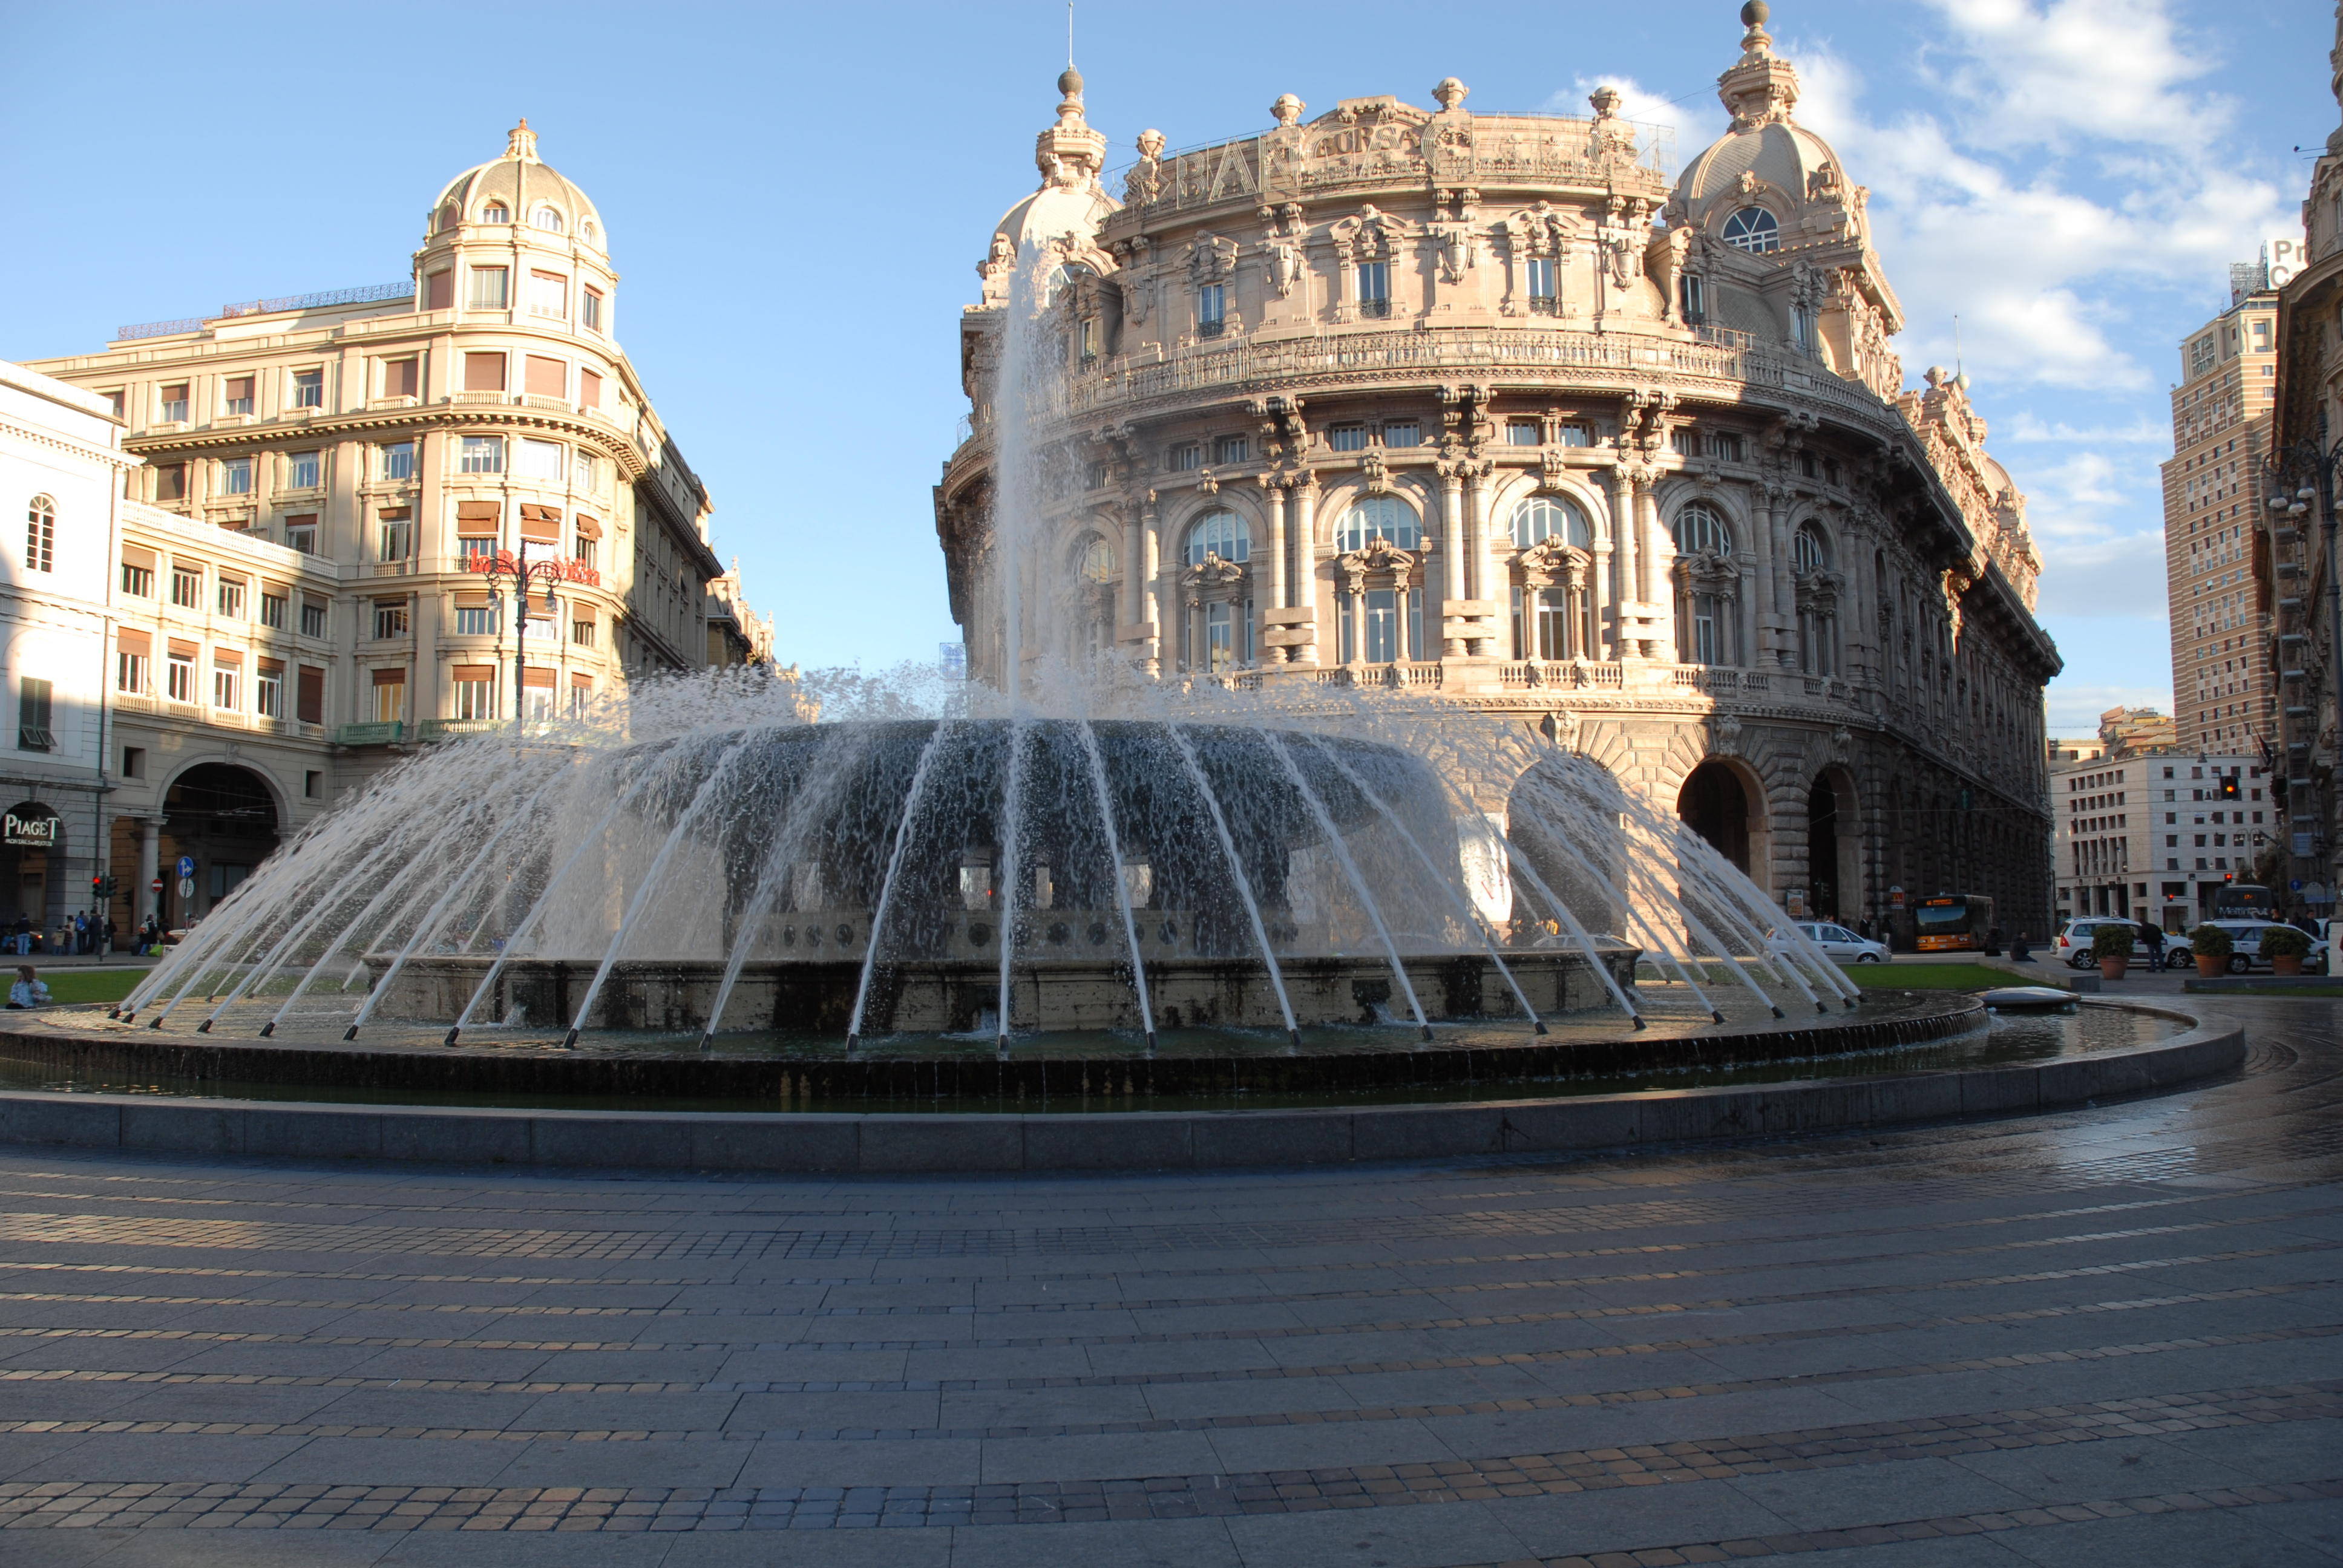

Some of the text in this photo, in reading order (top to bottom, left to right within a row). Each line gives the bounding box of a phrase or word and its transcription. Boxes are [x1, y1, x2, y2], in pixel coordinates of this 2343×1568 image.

[1316, 125, 1421, 158] BORSA
[1176, 111, 1414, 211] BANCA
[470, 548, 490, 573] la
[4, 814, 60, 840] PIAGET
